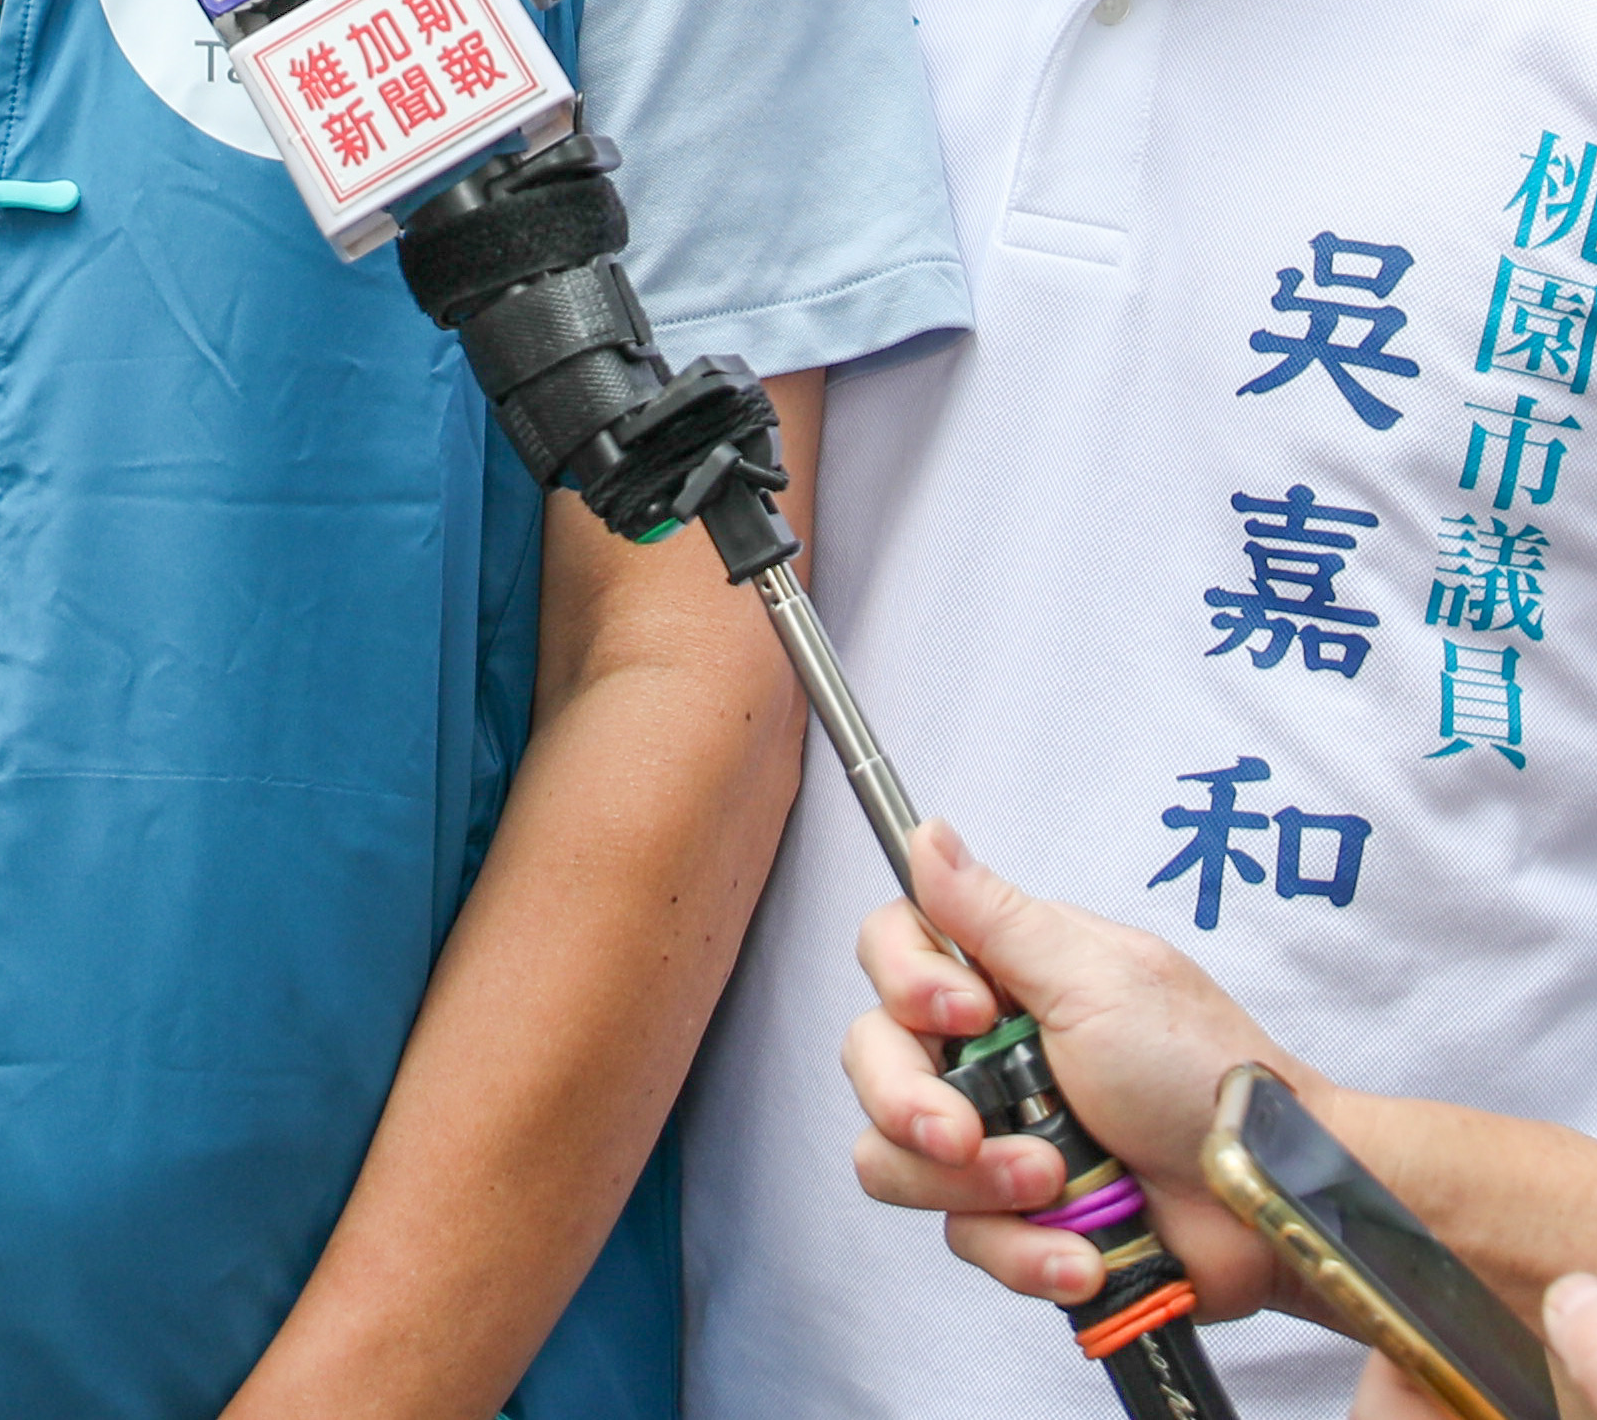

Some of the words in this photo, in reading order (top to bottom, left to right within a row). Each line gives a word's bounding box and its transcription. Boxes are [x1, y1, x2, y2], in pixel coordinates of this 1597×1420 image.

[319, 29, 509, 167] 新聞報
[1147, 230, 1420, 931] 吳嘉和
